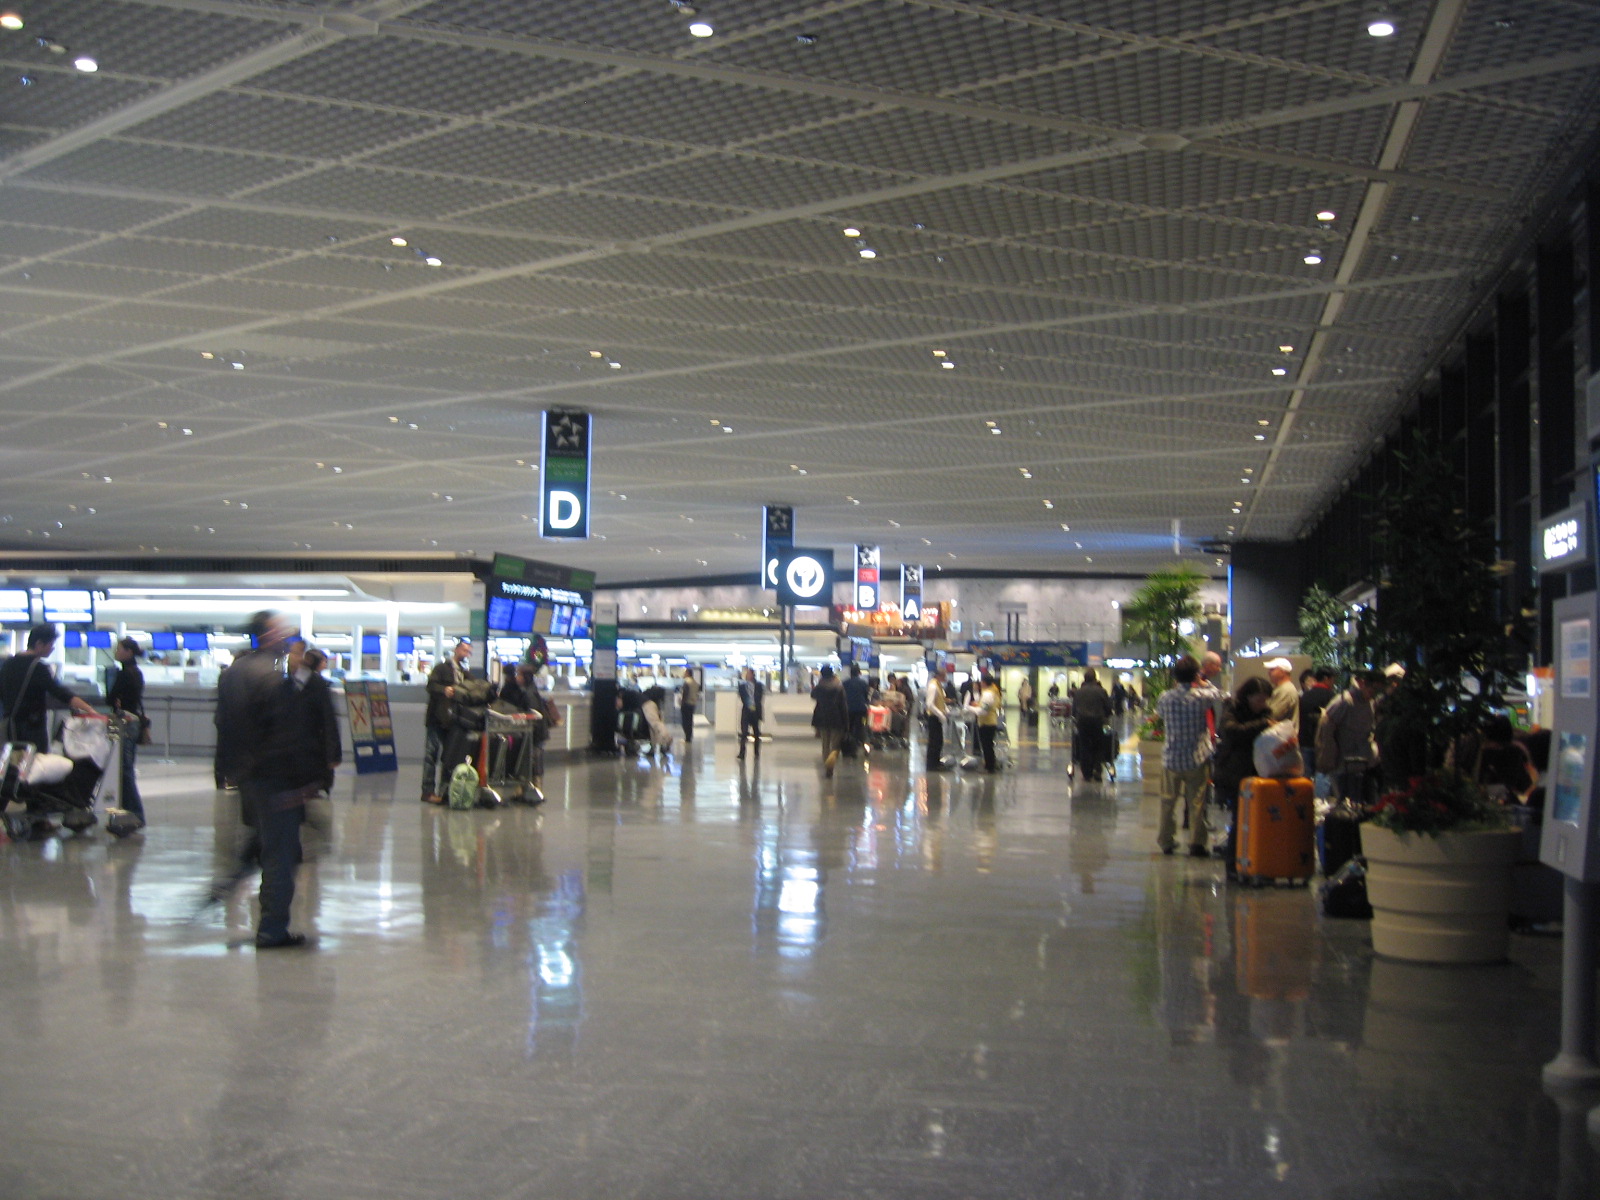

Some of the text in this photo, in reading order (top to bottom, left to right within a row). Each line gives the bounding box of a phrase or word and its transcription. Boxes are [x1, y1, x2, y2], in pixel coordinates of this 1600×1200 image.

[549, 490, 581, 530] D
[859, 585, 875, 608] B
[904, 598, 920, 619] A
